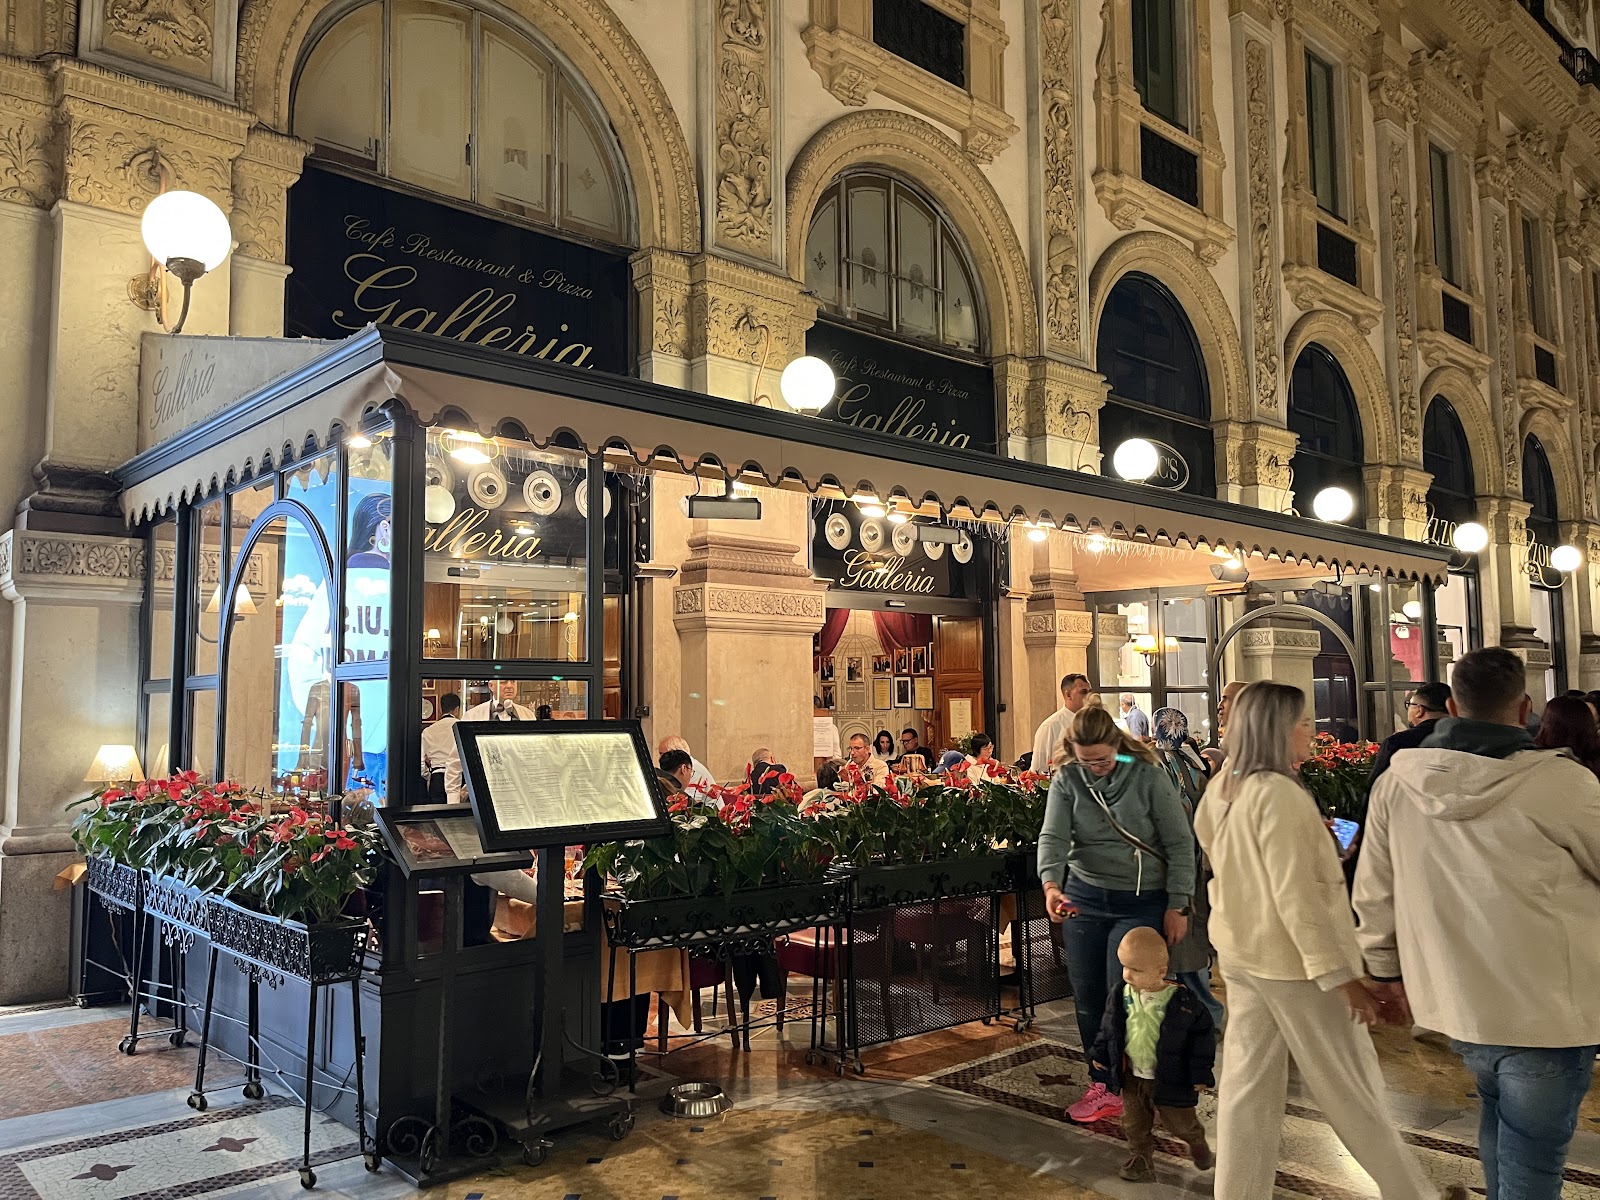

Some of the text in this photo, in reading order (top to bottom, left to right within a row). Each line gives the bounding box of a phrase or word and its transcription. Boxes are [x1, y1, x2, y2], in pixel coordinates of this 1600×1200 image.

[400, 233, 516, 279] Restaurant
[518, 268, 535, 284] &
[538, 269, 593, 299] Pizza
[149, 349, 216, 430] Galleria
[860, 358, 924, 388] Restaurant
[925, 379, 937, 391] &
[937, 378, 969, 400] Pizza
[839, 548, 936, 594] Galleria
